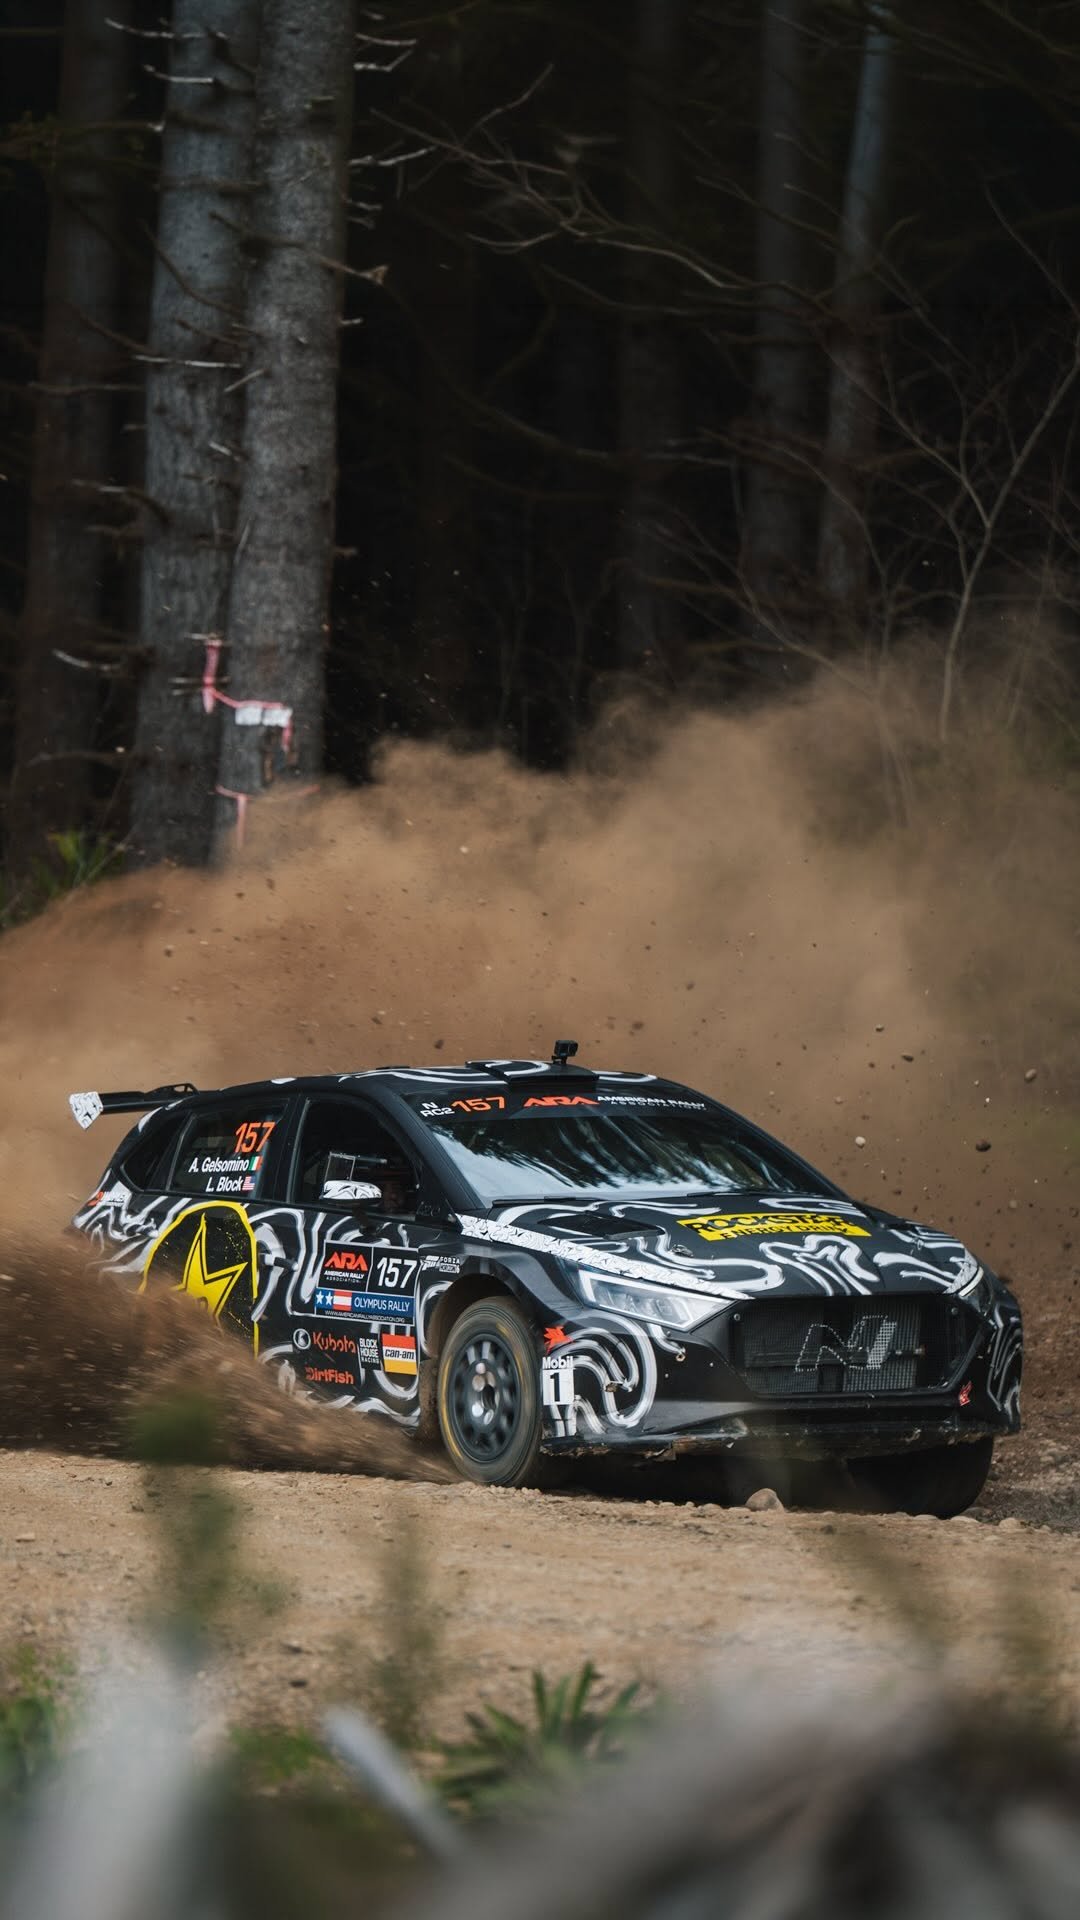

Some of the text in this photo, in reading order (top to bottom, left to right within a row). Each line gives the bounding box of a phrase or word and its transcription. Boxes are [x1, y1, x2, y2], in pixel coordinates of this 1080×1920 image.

[451, 1096, 505, 1112] 157
[523, 1096, 600, 1107] ARA
[235, 1121, 276, 1153] 157
[188, 1156, 250, 1173] A. Gelsomino
[205, 1176, 243, 1193] L. Block
[324, 1251, 369, 1272] ARA
[324, 1270, 349, 1279] AMERICAN
[376, 1257, 418, 1289] 157
[354, 1296, 411, 1312] OLYMPUS RALLY
[312, 1332, 356, 1354] Kubota
[359, 1338, 378, 1348] BLOCK
[360, 1347, 380, 1358] HOUSE
[384, 1349, 415, 1360] can-am
[542, 1356, 574, 1369] Mobil
[305, 1365, 354, 1385] DirtFish
[550, 1372, 560, 1402] 1
